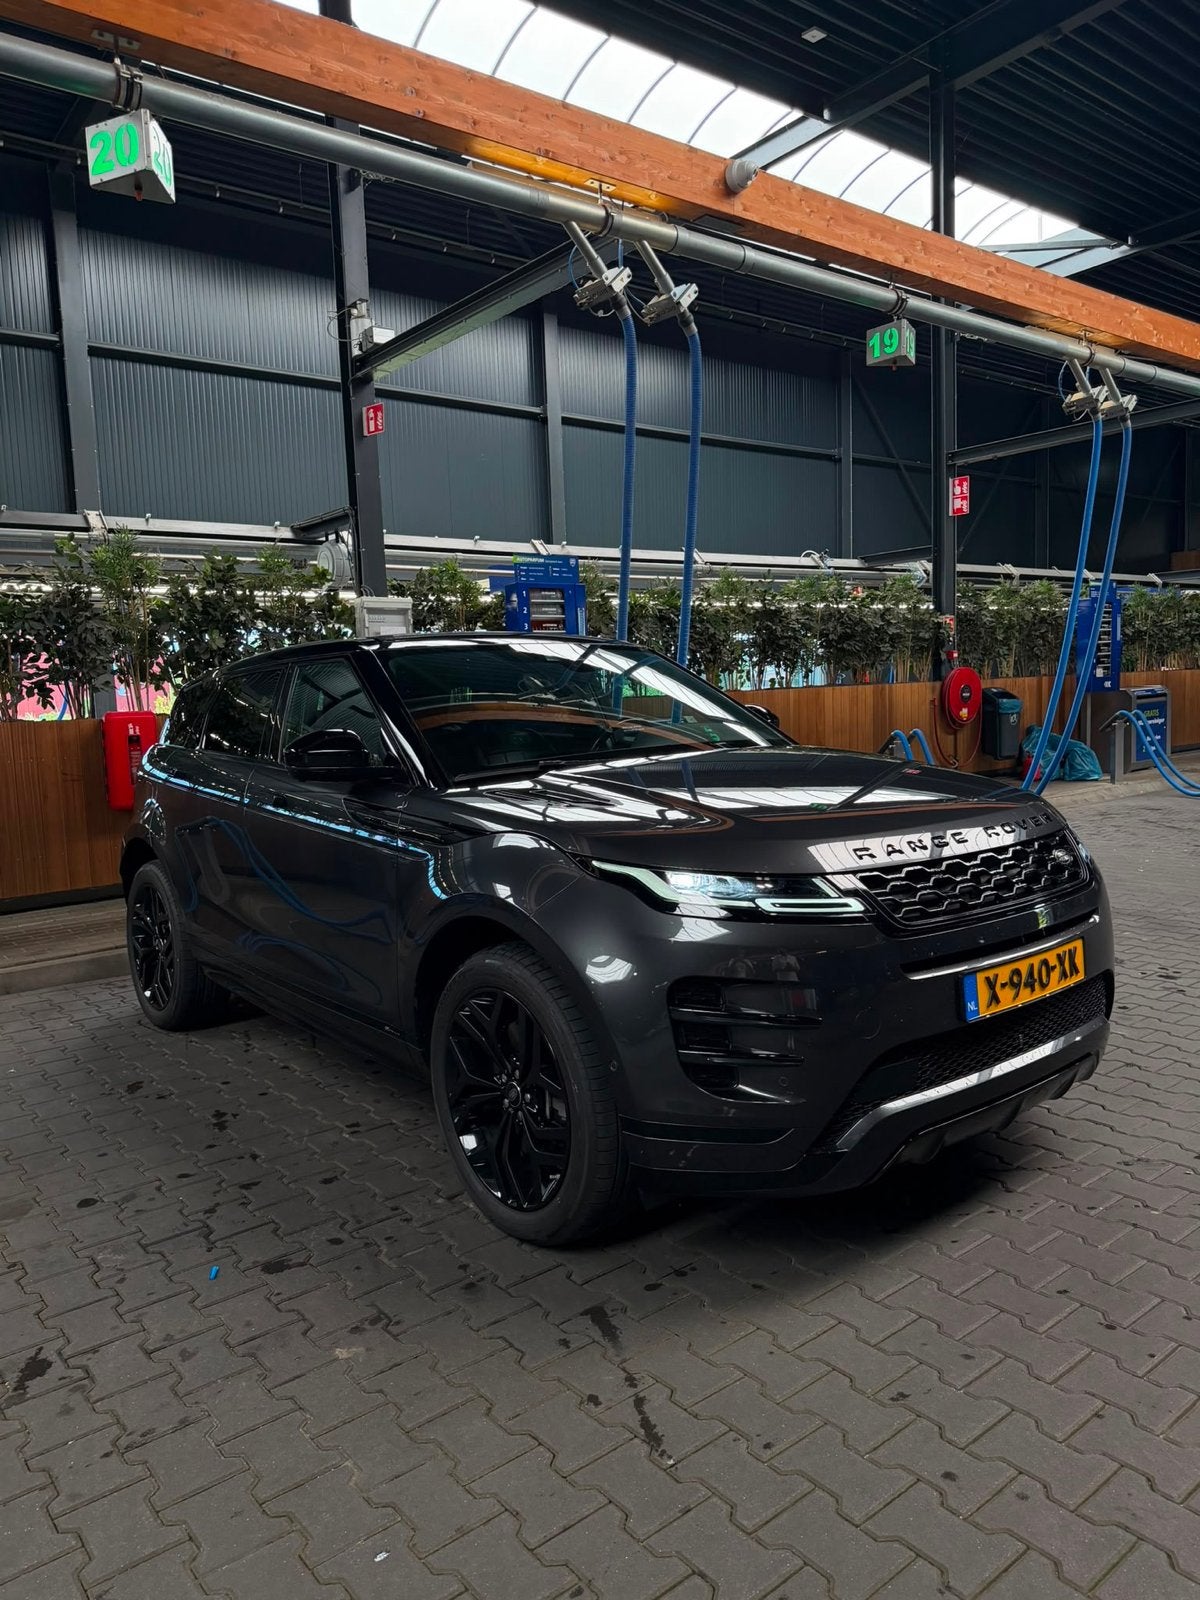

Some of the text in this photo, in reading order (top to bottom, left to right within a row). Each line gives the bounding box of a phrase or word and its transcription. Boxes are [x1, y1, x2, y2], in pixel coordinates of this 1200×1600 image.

[90, 122, 140, 176] 20
[868, 327, 899, 358] 19
[522, 590, 526, 598] 1
[852, 812, 1054, 861] RANGE ROVER
[984, 945, 1081, 1010] X-940-XK
[967, 1001, 978, 1012] NL
